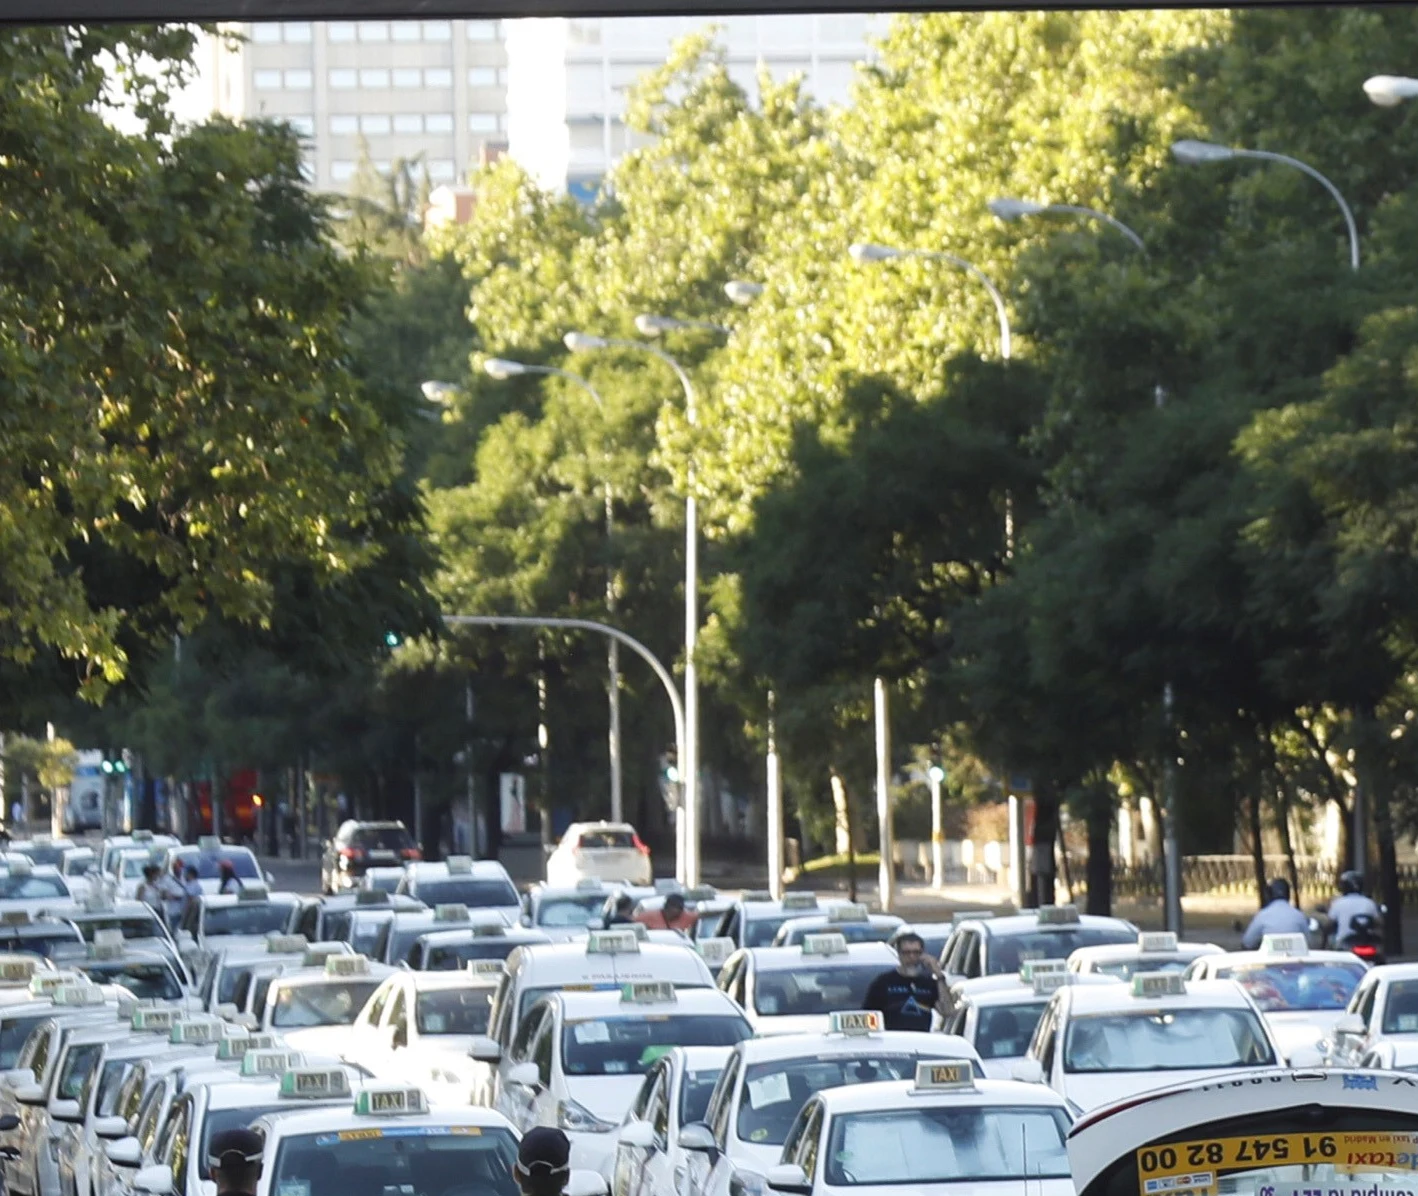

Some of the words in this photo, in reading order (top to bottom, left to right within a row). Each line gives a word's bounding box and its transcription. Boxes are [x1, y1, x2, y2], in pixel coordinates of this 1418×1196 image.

[257, 1054, 285, 1068] TAXI
[298, 1074, 327, 1090] TAXI
[932, 1066, 958, 1081] TAXI
[373, 1093, 404, 1109] TAXI
[1188, 1143, 1223, 1166] 82
[1236, 1138, 1289, 1161] 547
[1304, 1136, 1337, 1158] 91
[1141, 1148, 1176, 1172] 00
